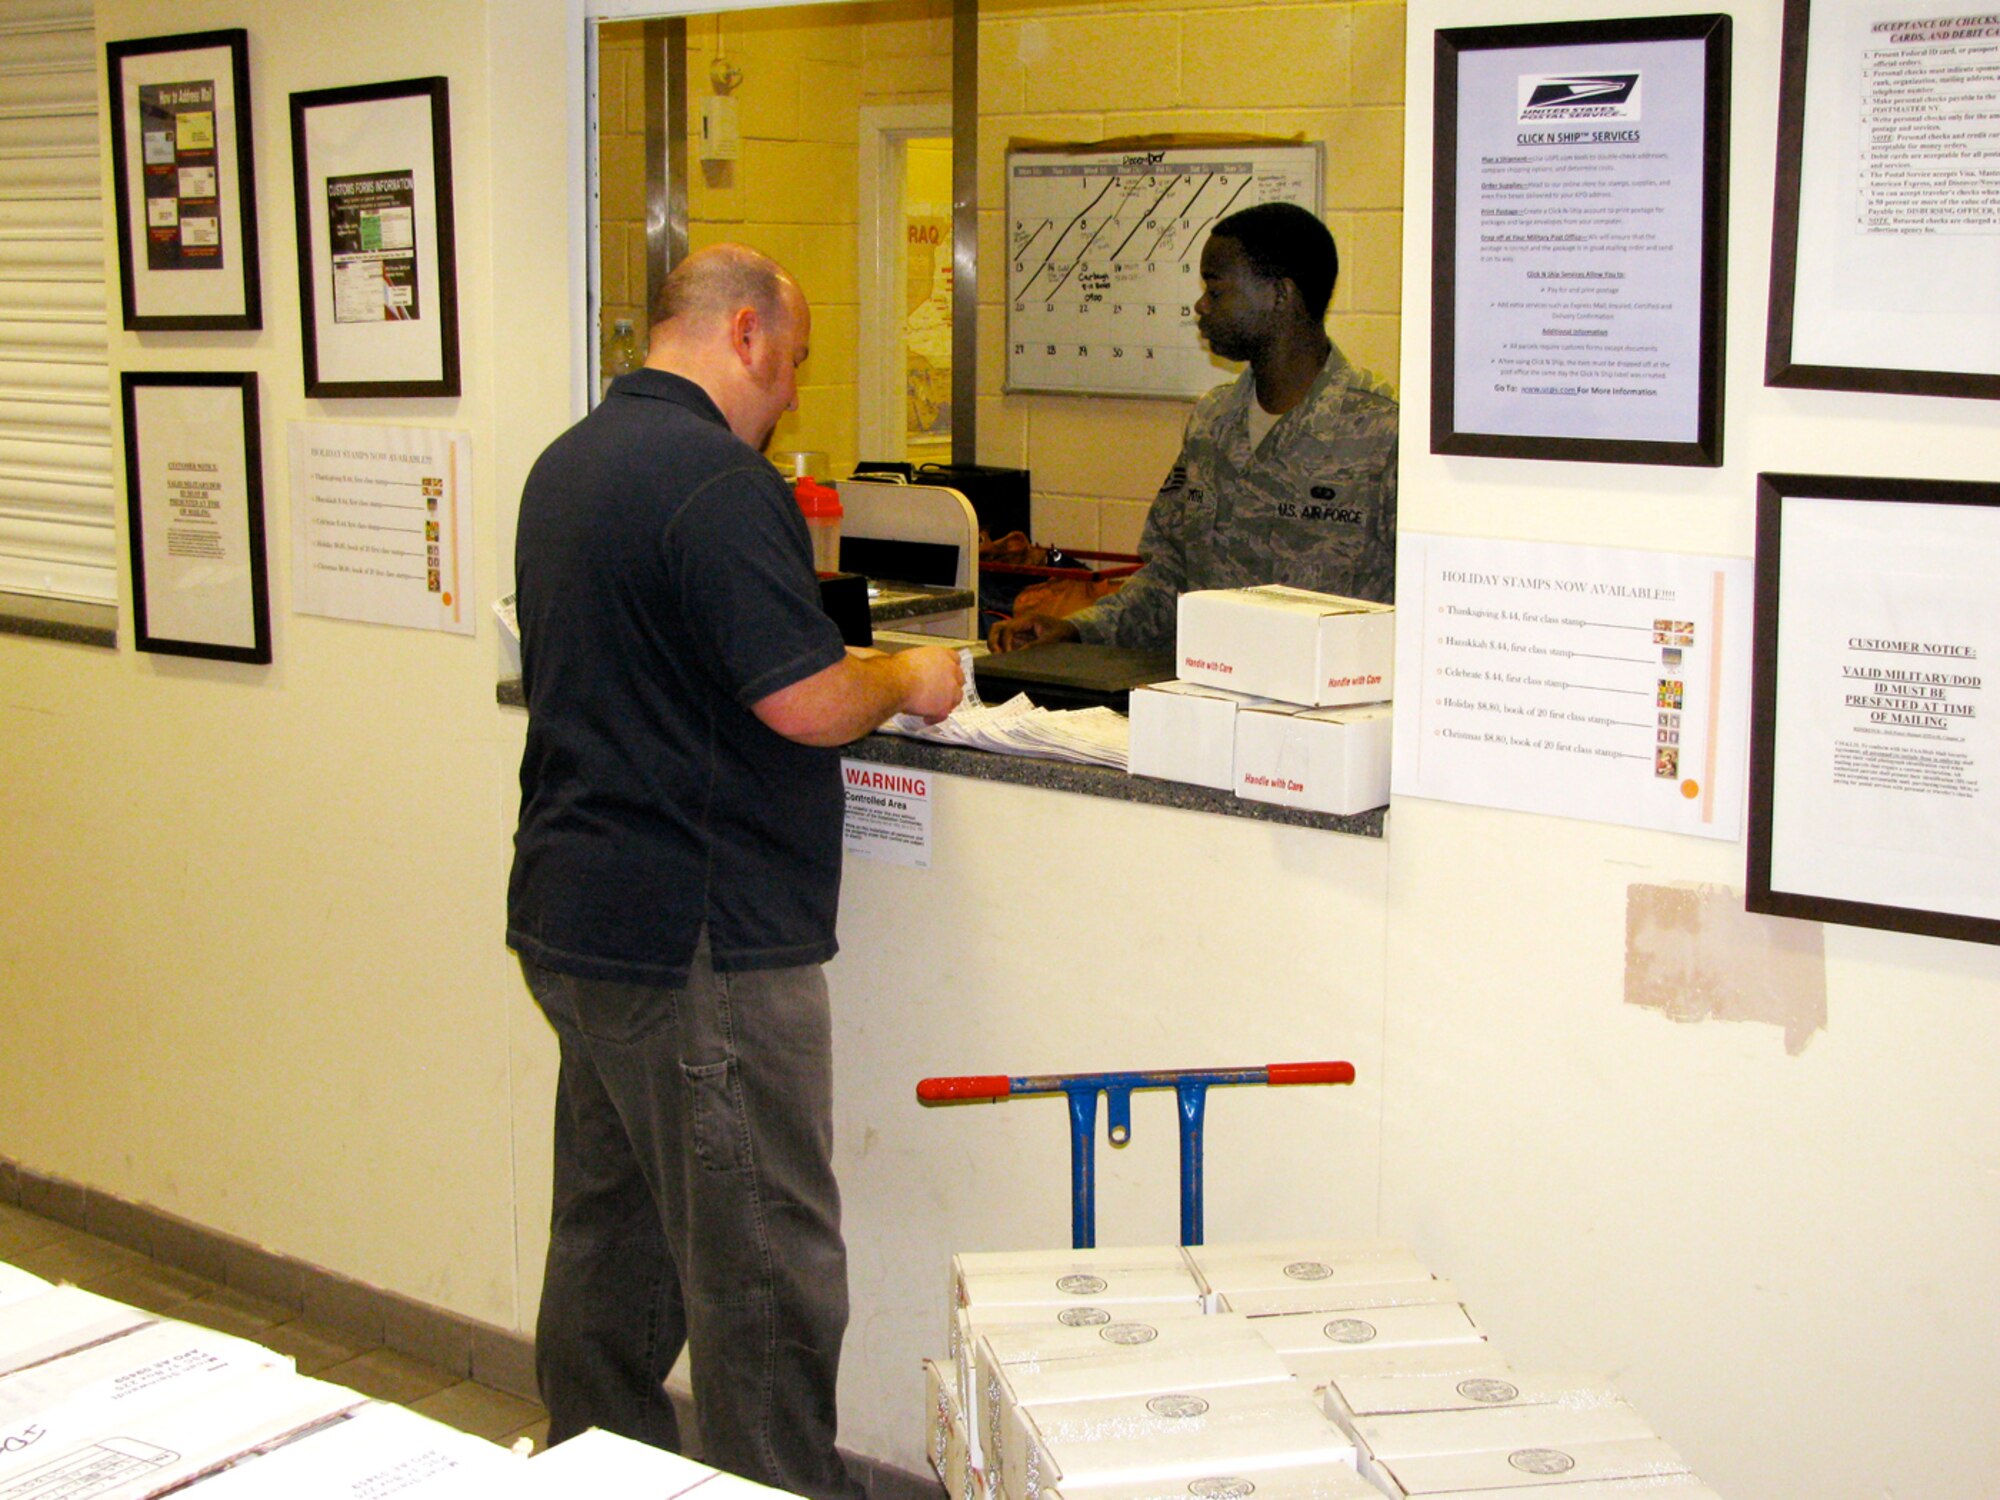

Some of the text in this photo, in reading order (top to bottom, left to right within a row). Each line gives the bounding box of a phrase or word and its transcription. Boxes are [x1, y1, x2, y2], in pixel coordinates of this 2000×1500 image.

[1872, 20, 1936, 32] ACCEPTANCE
[1939, 19, 1952, 28] OF
[1890, 28, 2000, 43] CARDS, AND DEBIT CA
[1523, 107, 1570, 115] UNITED
[1517, 133, 1544, 144] CLICK
[1547, 132, 1555, 143] N
[1592, 130, 1640, 142] SERVICES
[329, 178, 413, 197] CUSTOMS FORMS INFORMATION
[908, 225, 939, 245] RAQ
[1494, 384, 1506, 393] Go
[1591, 387, 1610, 396] More
[1612, 387, 1657, 396] Information
[1278, 504, 1362, 523] U.S. AIR FORCE
[1442, 571, 1500, 587] HOLIDAY
[1502, 575, 1551, 591] STAMPS
[1554, 581, 1586, 593] NOW
[1447, 605, 1499, 620] Thanksgiving
[1522, 612, 1538, 623] first
[1540, 614, 1559, 624] class
[1511, 643, 1527, 654] first
[1528, 645, 1547, 655] class
[1849, 638, 1977, 657] CUSTOMER NOTICE:
[1185, 658, 1233, 674] Handle with Care
[1328, 675, 1381, 688] Handle with Care
[1445, 667, 1482, 680] Celebrate
[1506, 673, 1521, 684] first
[1523, 675, 1542, 685] class
[1843, 666, 1981, 687] VALID MILITARY/DOD
[1875, 683, 1946, 698] ID MUST BE
[1443, 698, 1475, 712] Holiday
[1504, 704, 1524, 715] book
[1526, 705, 1535, 715] of
[1537, 706, 1547, 717] 20
[1549, 709, 1565, 720] first
[1567, 710, 1586, 721] class
[1845, 695, 1976, 715] PRESENTED AT TIME
[1871, 712, 1947, 728] OF MAILING
[1442, 728, 1481, 740] Christmas
[1510, 735, 1530, 747] book
[1533, 736, 1542, 748] of
[1544, 738, 1554, 749] 20
[1556, 741, 1571, 752] first
[1573, 743, 1592, 753] class
[846, 768, 926, 796] WARNING
[1245, 773, 1303, 793] Handle with Care
[845, 791, 907, 810] Controlled Area
